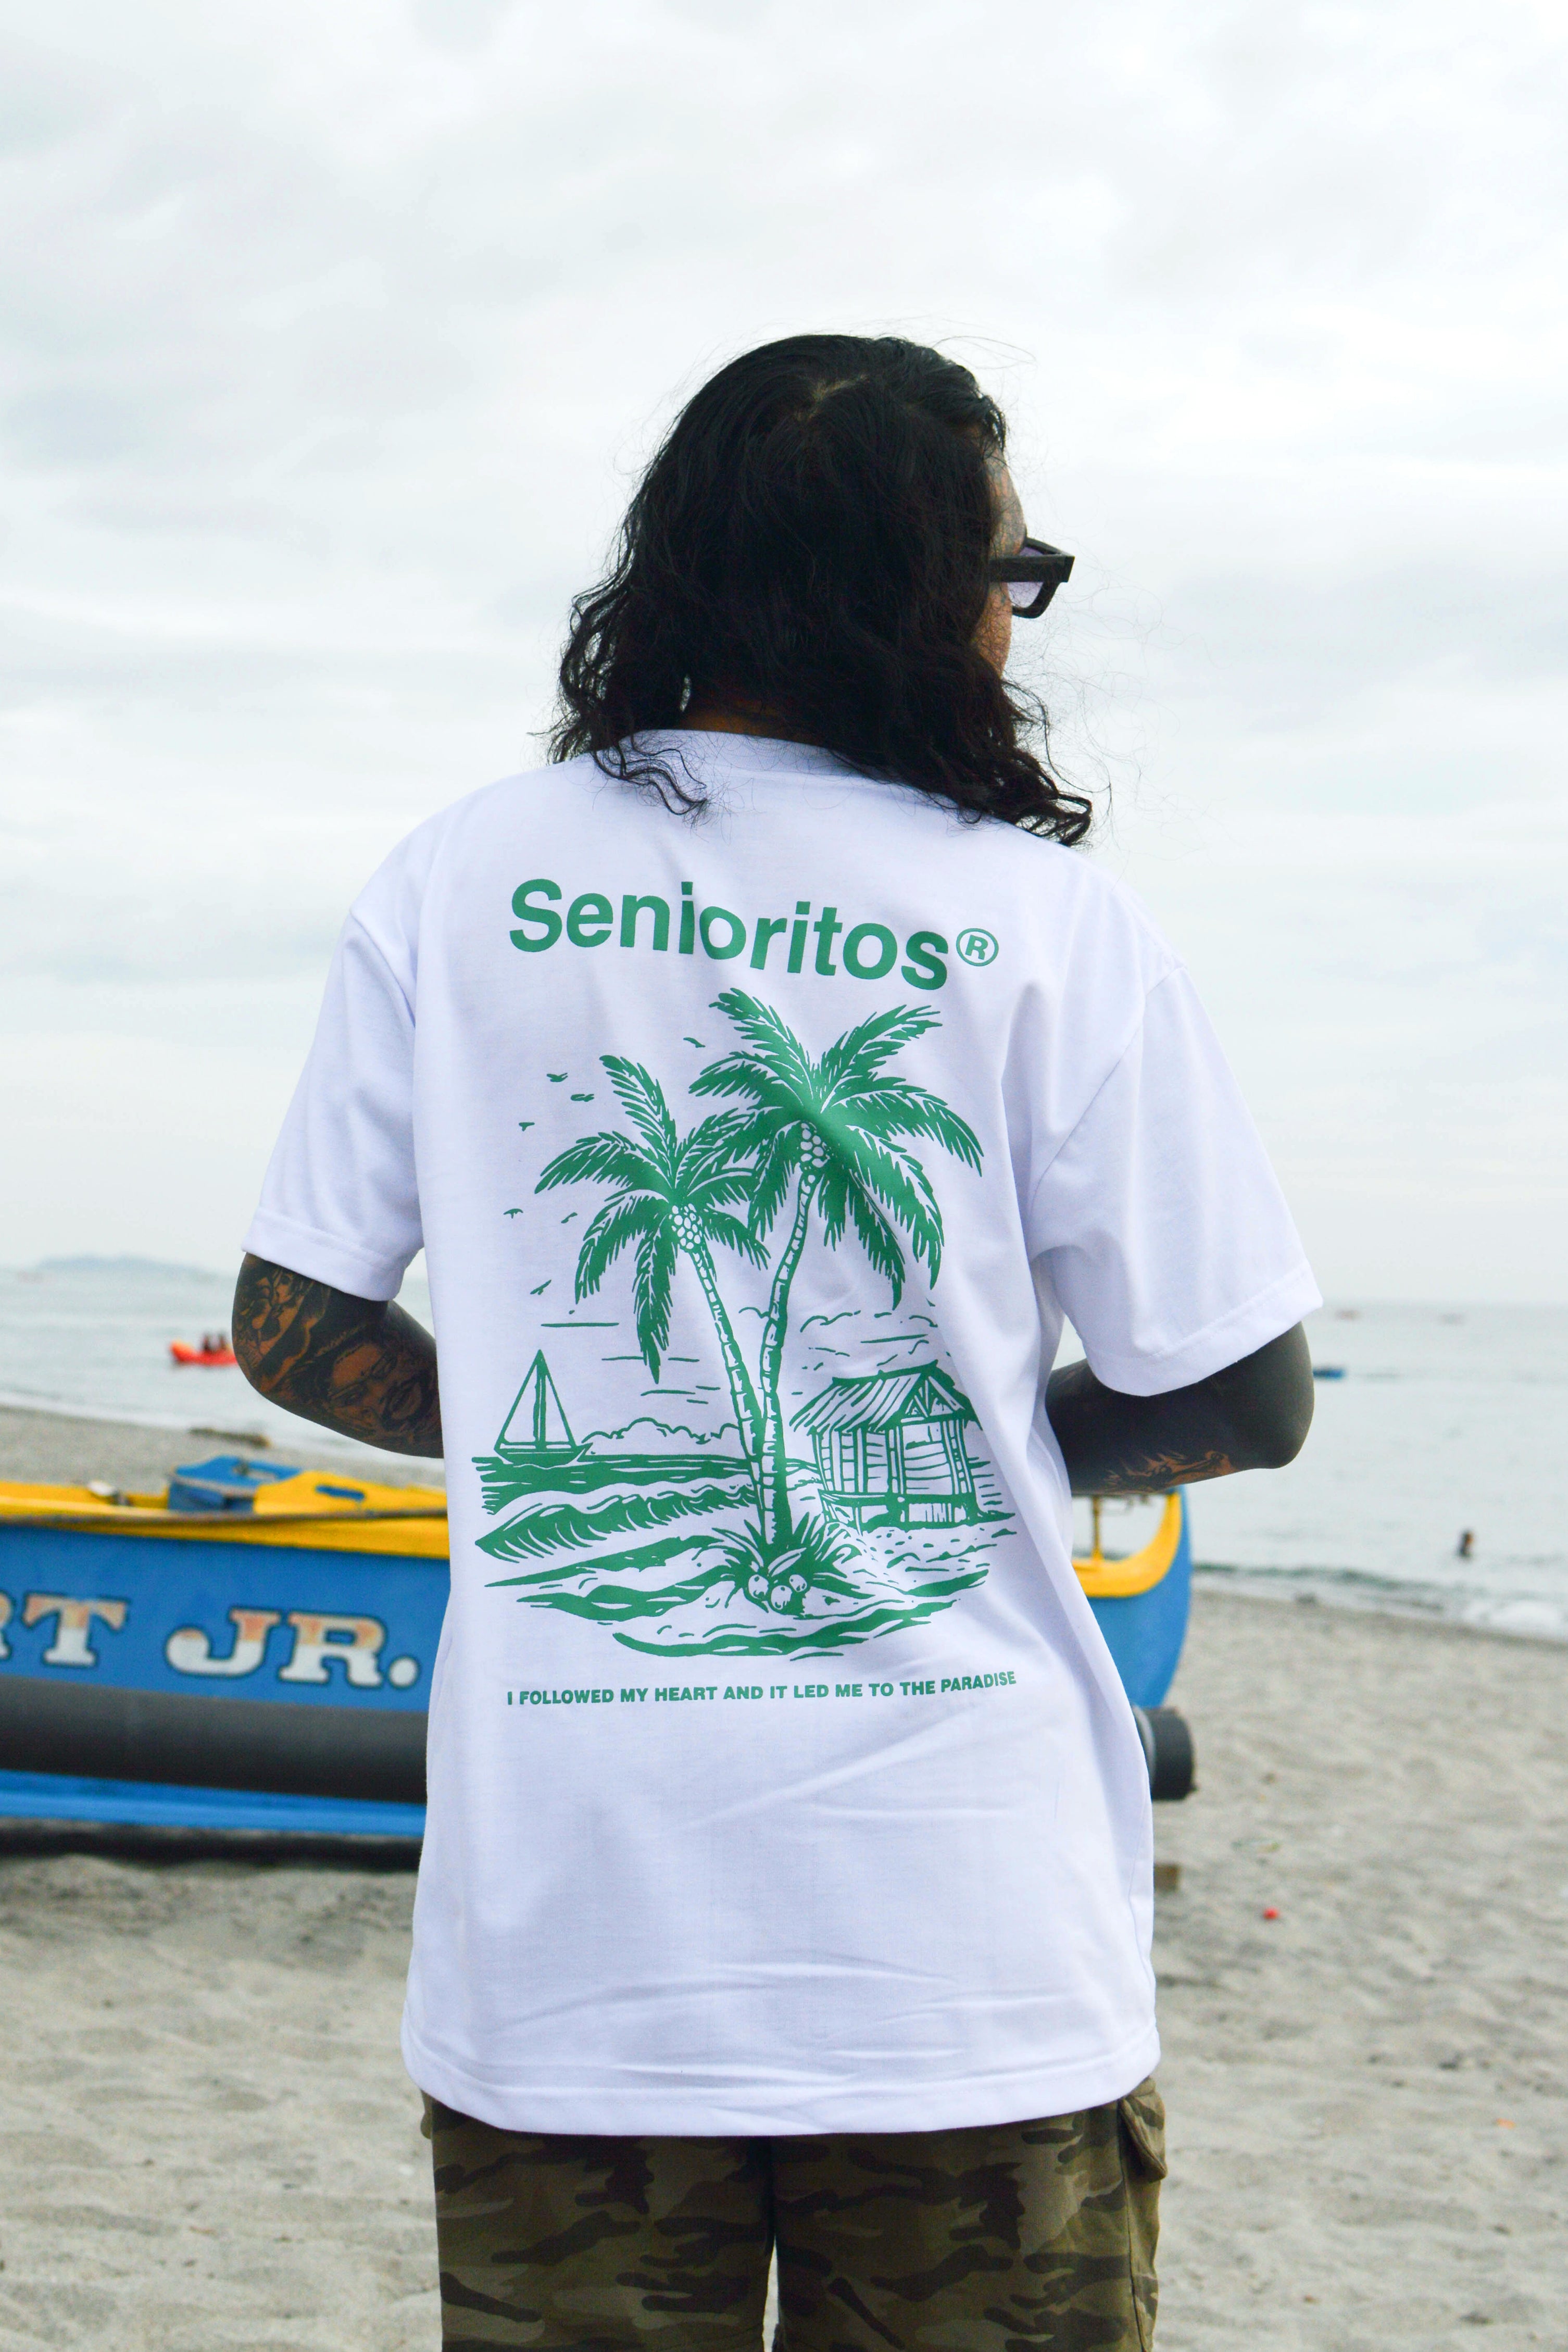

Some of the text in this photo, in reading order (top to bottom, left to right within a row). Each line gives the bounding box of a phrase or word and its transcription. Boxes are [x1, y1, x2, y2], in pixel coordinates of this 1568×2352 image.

[0, 1591, 419, 1690] T JR.
[507, 1671, 1017, 1706] I FOLLOWED MY HEART AND IT LED ME TO THE PARADISE
